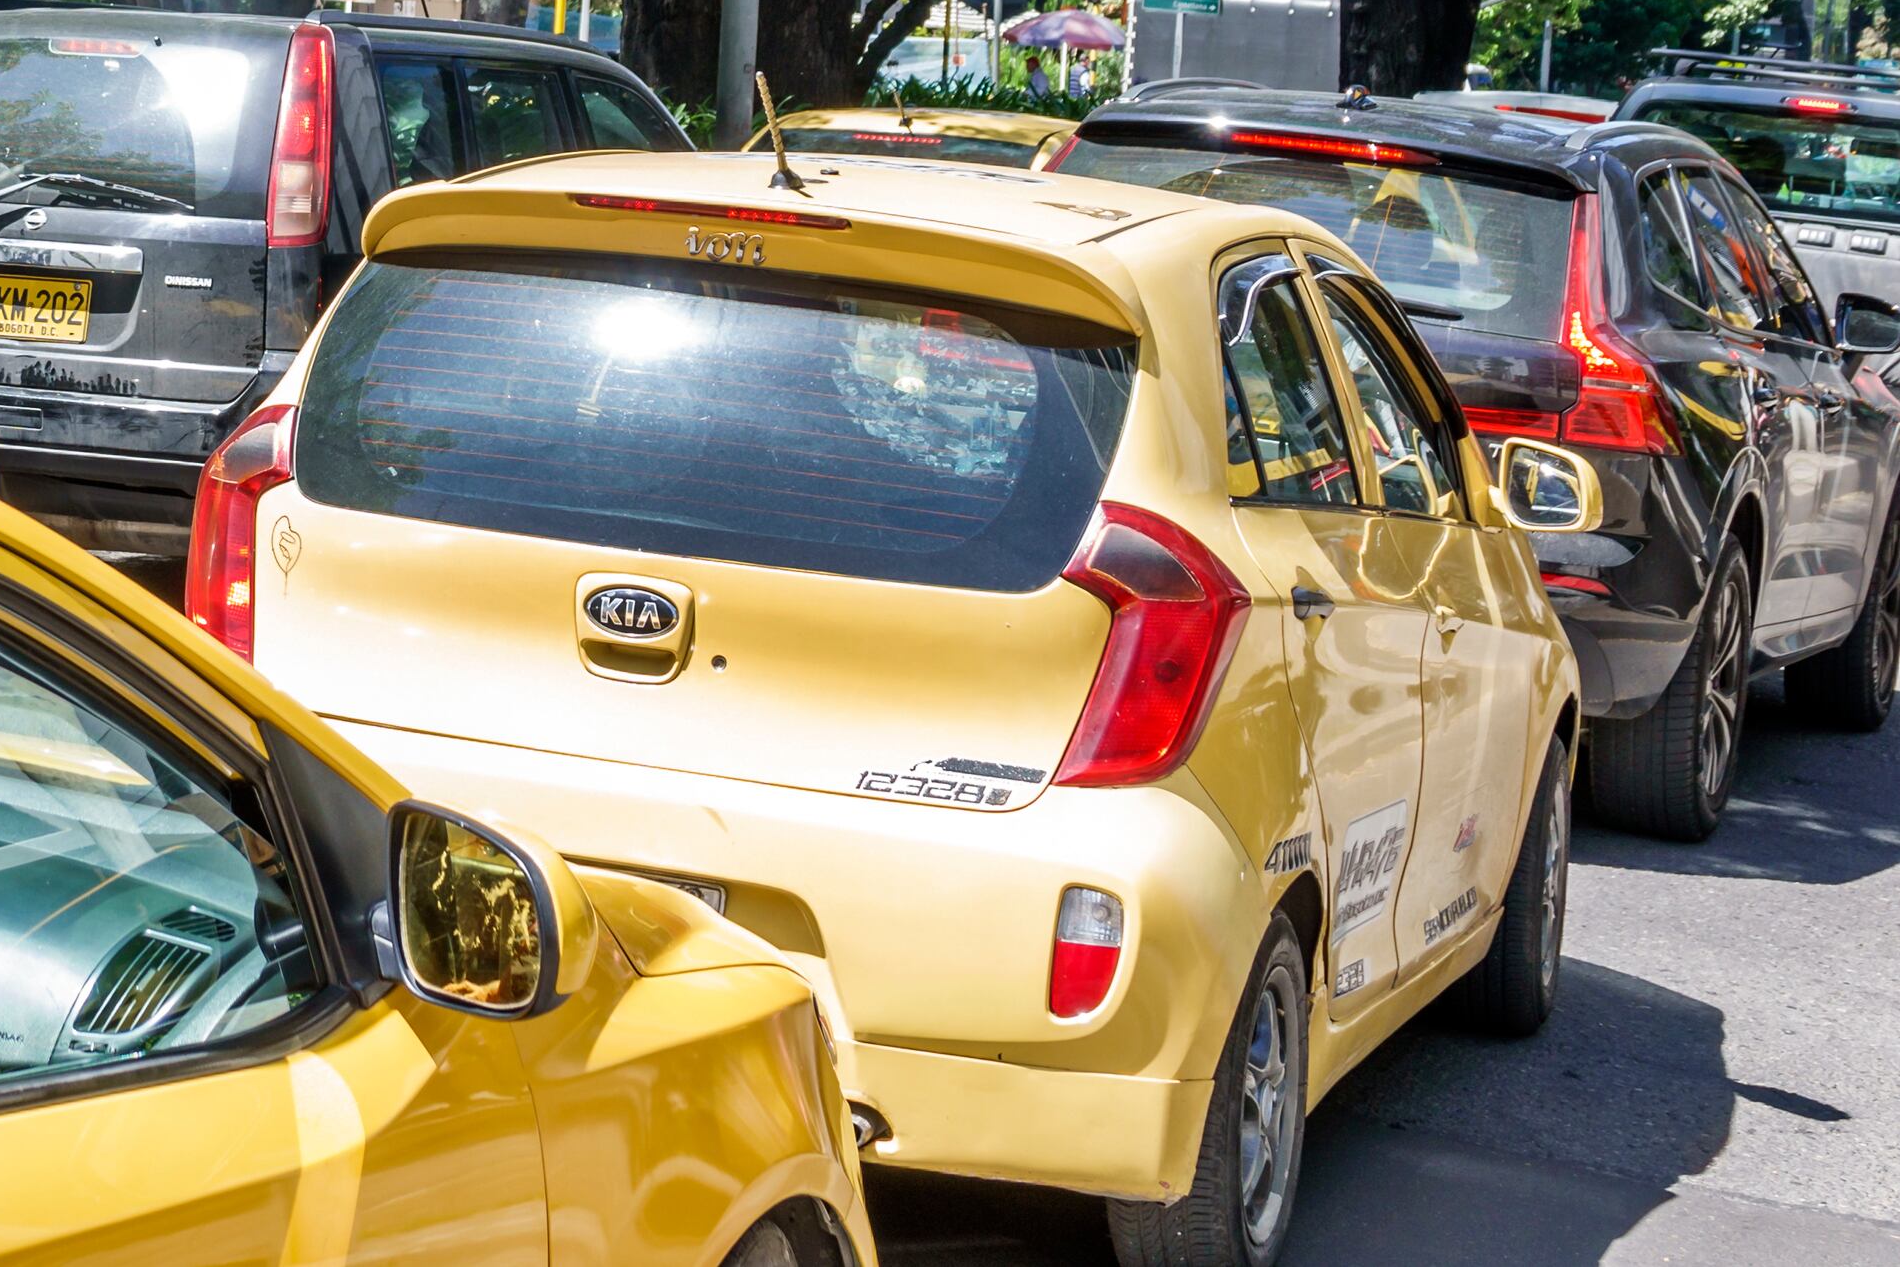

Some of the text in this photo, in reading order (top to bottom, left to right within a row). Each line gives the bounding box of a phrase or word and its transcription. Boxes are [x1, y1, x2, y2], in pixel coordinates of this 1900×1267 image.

[684, 224, 767, 266] ion
[34, 289, 85, 326] 202
[0, 323, 59, 337] BOGOTA D.C.
[601, 596, 661, 629] KIA
[856, 770, 986, 804] 12328
